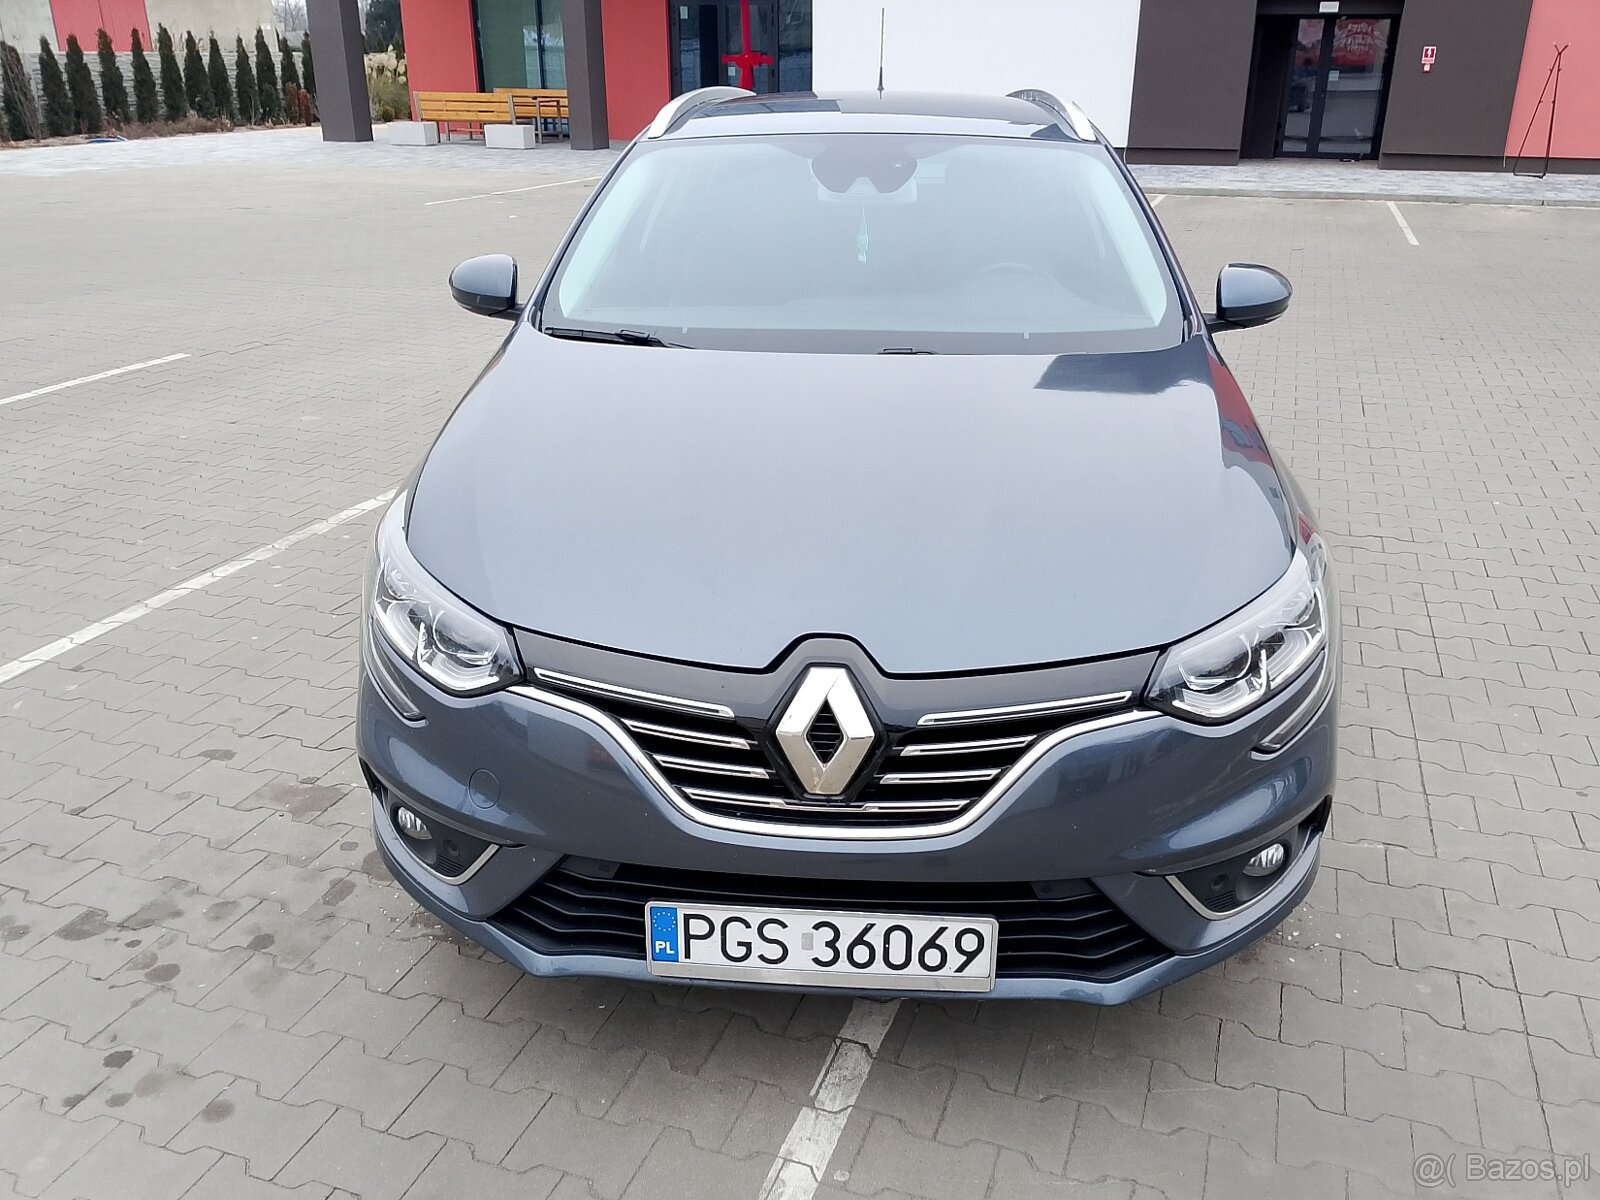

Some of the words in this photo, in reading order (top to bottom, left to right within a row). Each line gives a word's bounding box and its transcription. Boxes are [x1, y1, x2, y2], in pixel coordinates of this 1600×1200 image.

[655, 940, 675, 954] PL
[683, 913, 789, 965] PGS
[811, 920, 985, 973] 36069
